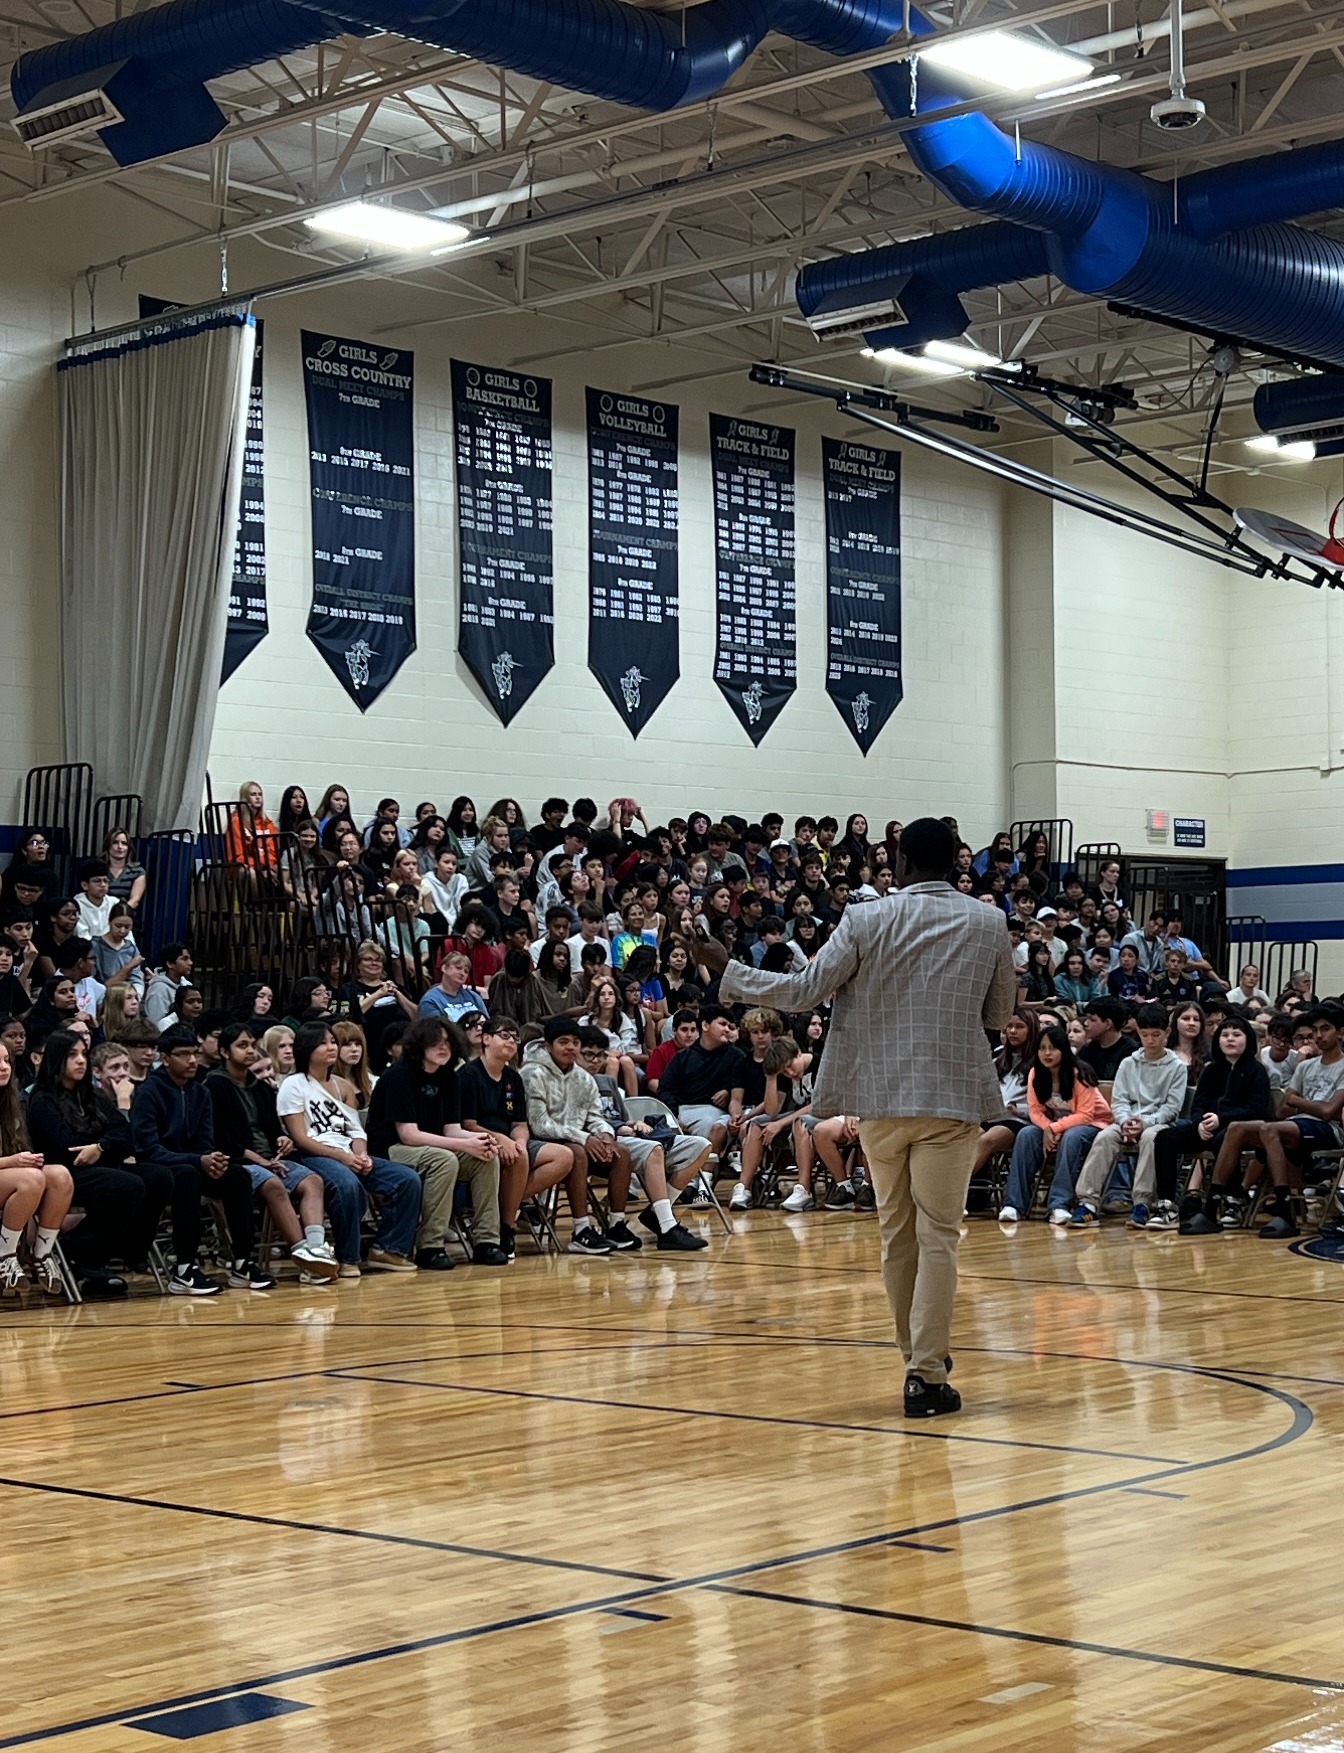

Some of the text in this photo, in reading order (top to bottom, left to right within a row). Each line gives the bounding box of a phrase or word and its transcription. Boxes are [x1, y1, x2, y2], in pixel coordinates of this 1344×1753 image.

[339, 345, 378, 364] GIRLS
[306, 357, 412, 389] CROSS COUNTRY
[484, 373, 520, 391] GIRLS
[352, 395, 380, 408] GRADE
[465, 386, 540, 413] BASKETBALL
[617, 400, 649, 418] GIRLS
[599, 412, 667, 437] VOLLEYBALL
[738, 424, 768, 440] GIRLS
[716, 436, 750, 454] TRACK
[760, 445, 790, 460] FIELD
[848, 447, 876, 461] GIRLS
[828, 457, 859, 475] TRACK
[869, 466, 895, 481] FIELD
[354, 507, 383, 519] GRADE
[355, 548, 383, 560] GRADE
